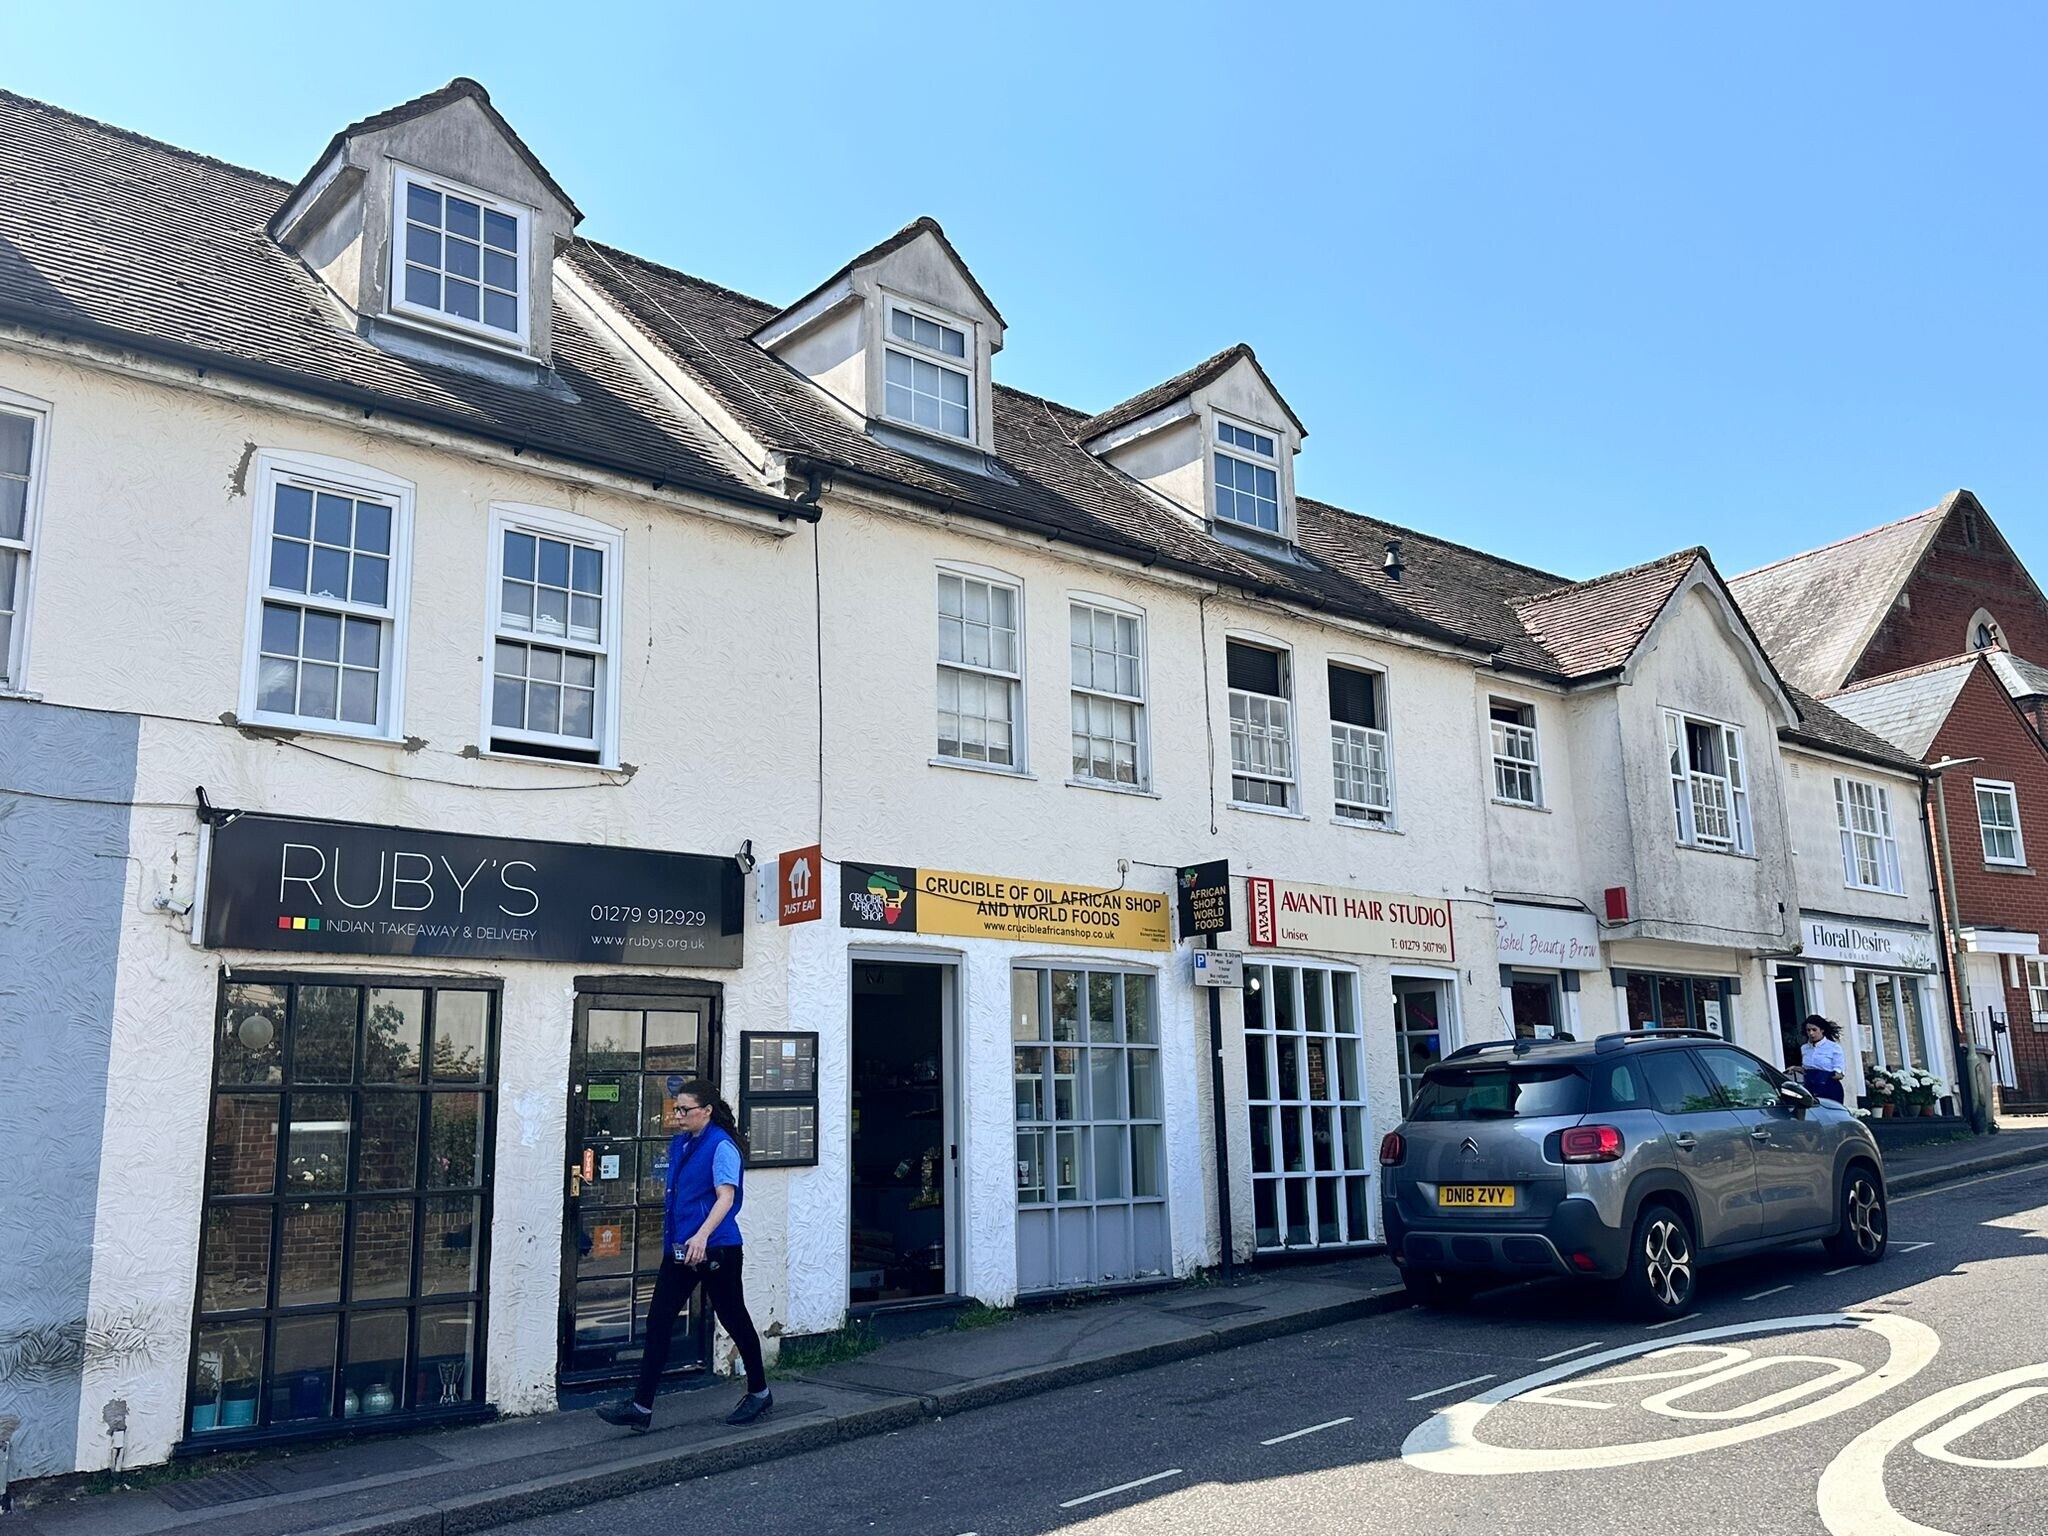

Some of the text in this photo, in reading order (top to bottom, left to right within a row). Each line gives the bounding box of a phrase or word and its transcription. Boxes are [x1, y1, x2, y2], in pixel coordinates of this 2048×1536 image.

[280, 843, 539, 917] RUBY'S
[926, 877, 1161, 913] CRUCIBLE OF OIL AFRICAN SHOP
[1190, 885, 1226, 900] AFRICAN
[783, 899, 817, 917] JUST EAT
[851, 901, 884, 912] AFRICAN
[1193, 897, 1224, 910] SHOP &
[1257, 883, 1269, 941] AVANTI
[1281, 891, 1446, 928] AVANTI HAIR STUDIO
[590, 904, 706, 927] 01279 912929
[861, 910, 884, 921] SHOP
[976, 900, 1120, 926] AND WORLD FOODS
[1193, 907, 1224, 920] WORLD
[326, 919, 538, 941] INDIAN TAKEAWAY & DELIVERY
[983, 921, 1115, 940] www.crucibleafricanshop.co.uk
[1195, 918, 1224, 930] FOODS
[591, 935, 705, 951] www.rubys.org.uk
[1281, 927, 1309, 941] Unisex
[1812, 924, 1891, 953] Floral Desire
[1399, 939, 1420, 951] 01279
[1423, 941, 1447, 954] 507190
[1529, 933, 1565, 963] Beauty
[1569, 938, 1597, 958] Brow
[1446, 1188, 1506, 1203] DN18 ZVY
[1508, 1343, 1867, 1420] 20
